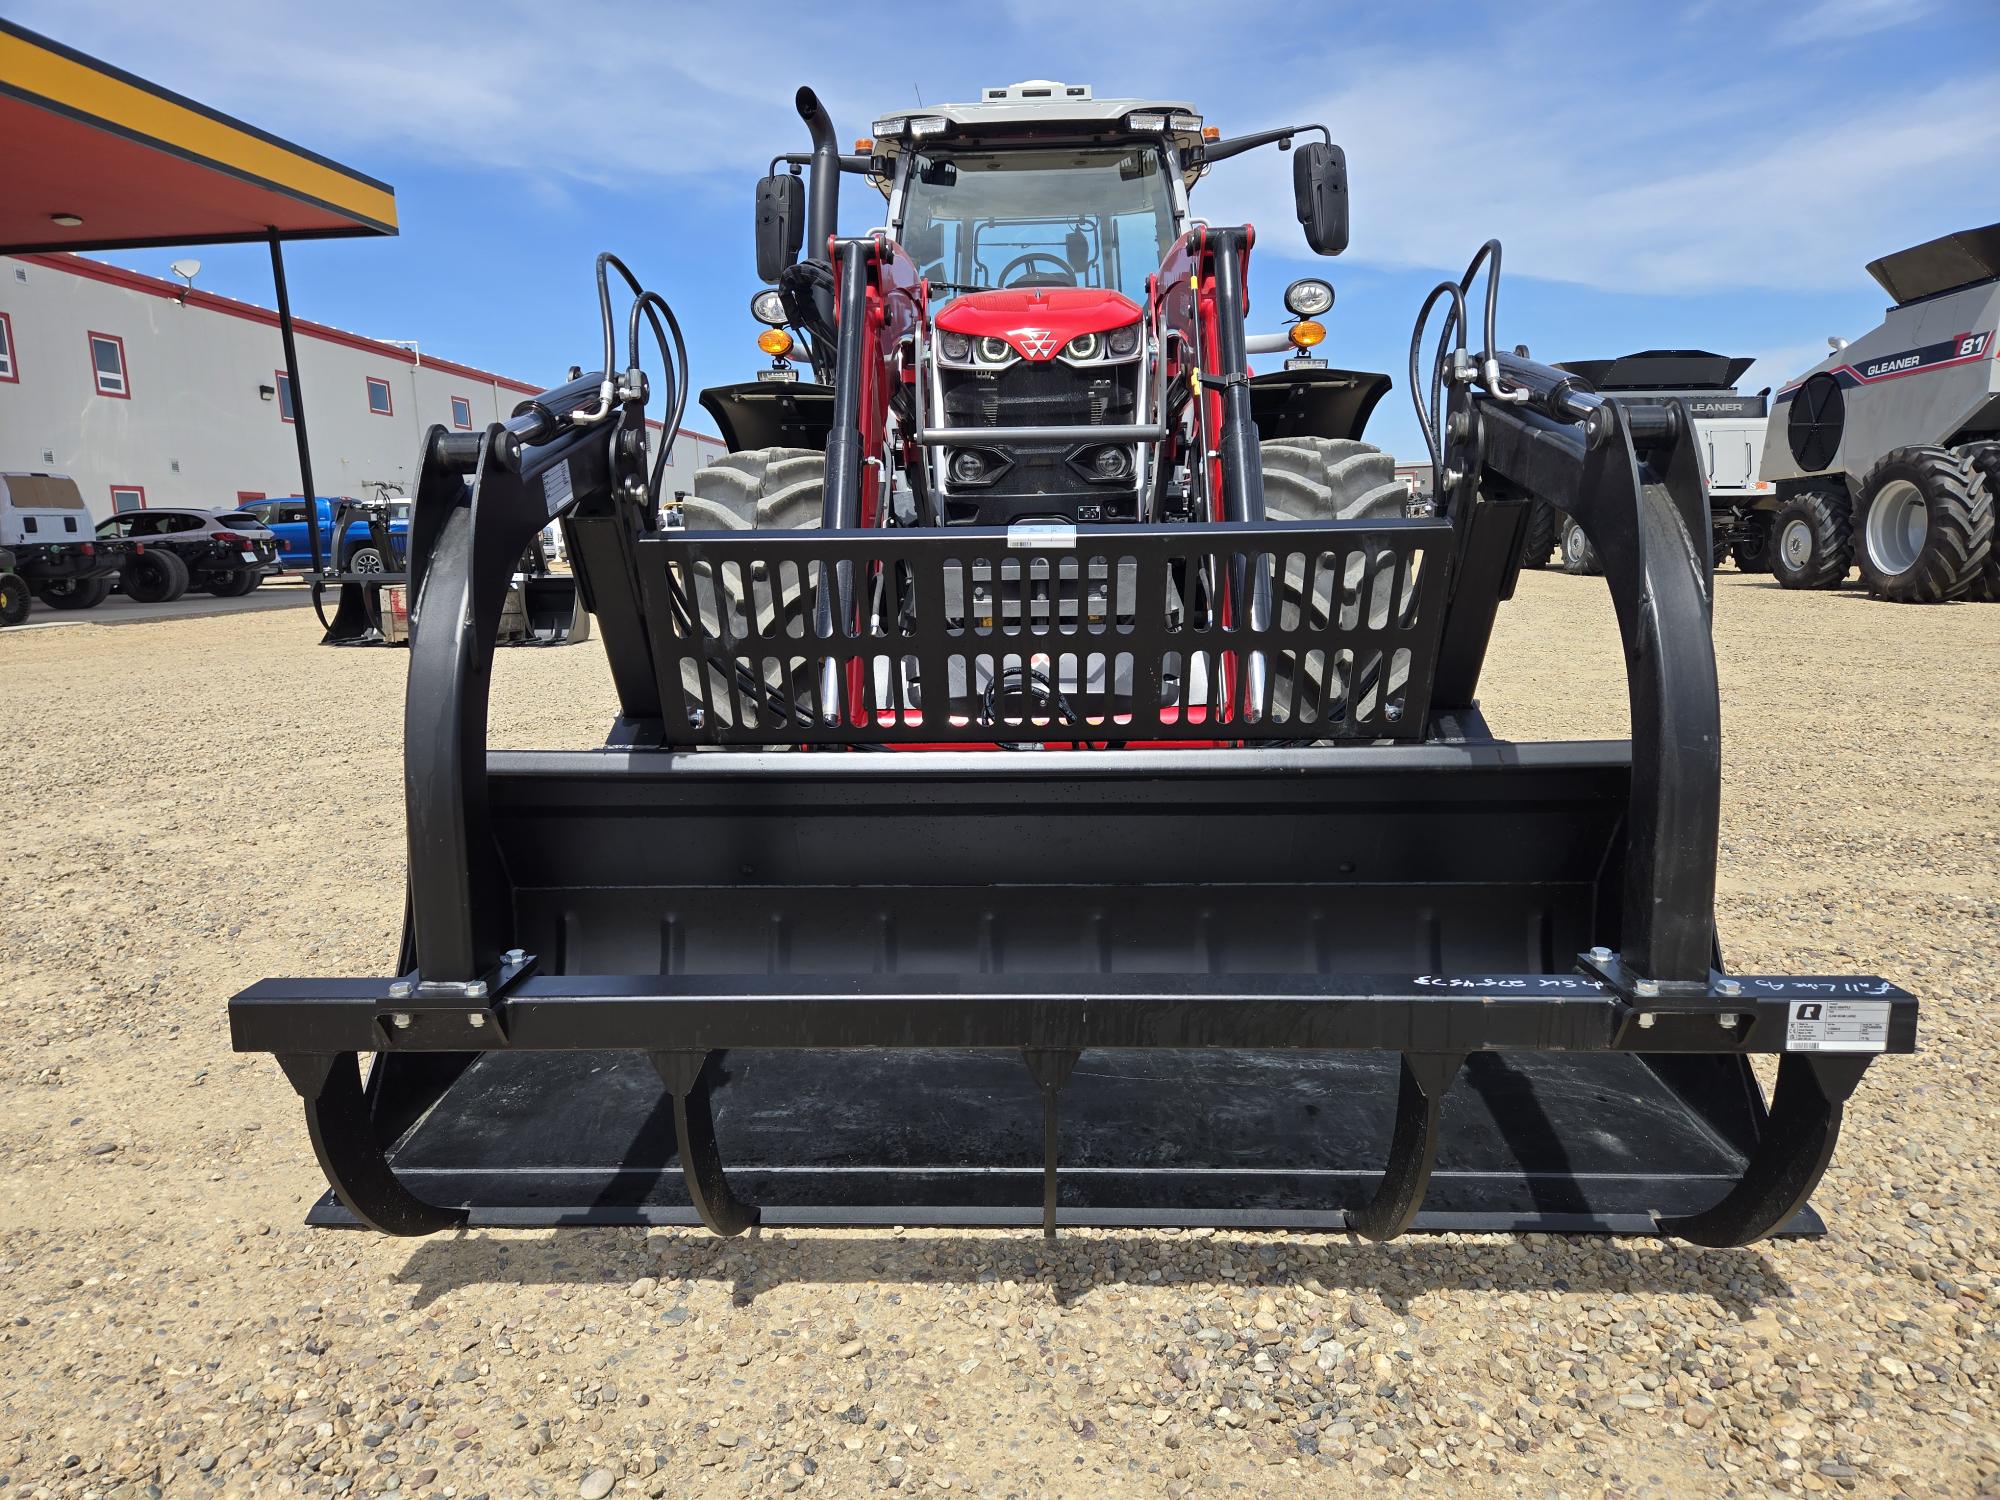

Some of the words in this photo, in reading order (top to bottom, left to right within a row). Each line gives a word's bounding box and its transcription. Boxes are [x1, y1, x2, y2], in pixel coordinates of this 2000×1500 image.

[1953, 331, 1985, 357] T81
[1866, 355, 1920, 377] GLEANER
[1688, 403, 1744, 412] LEANER
